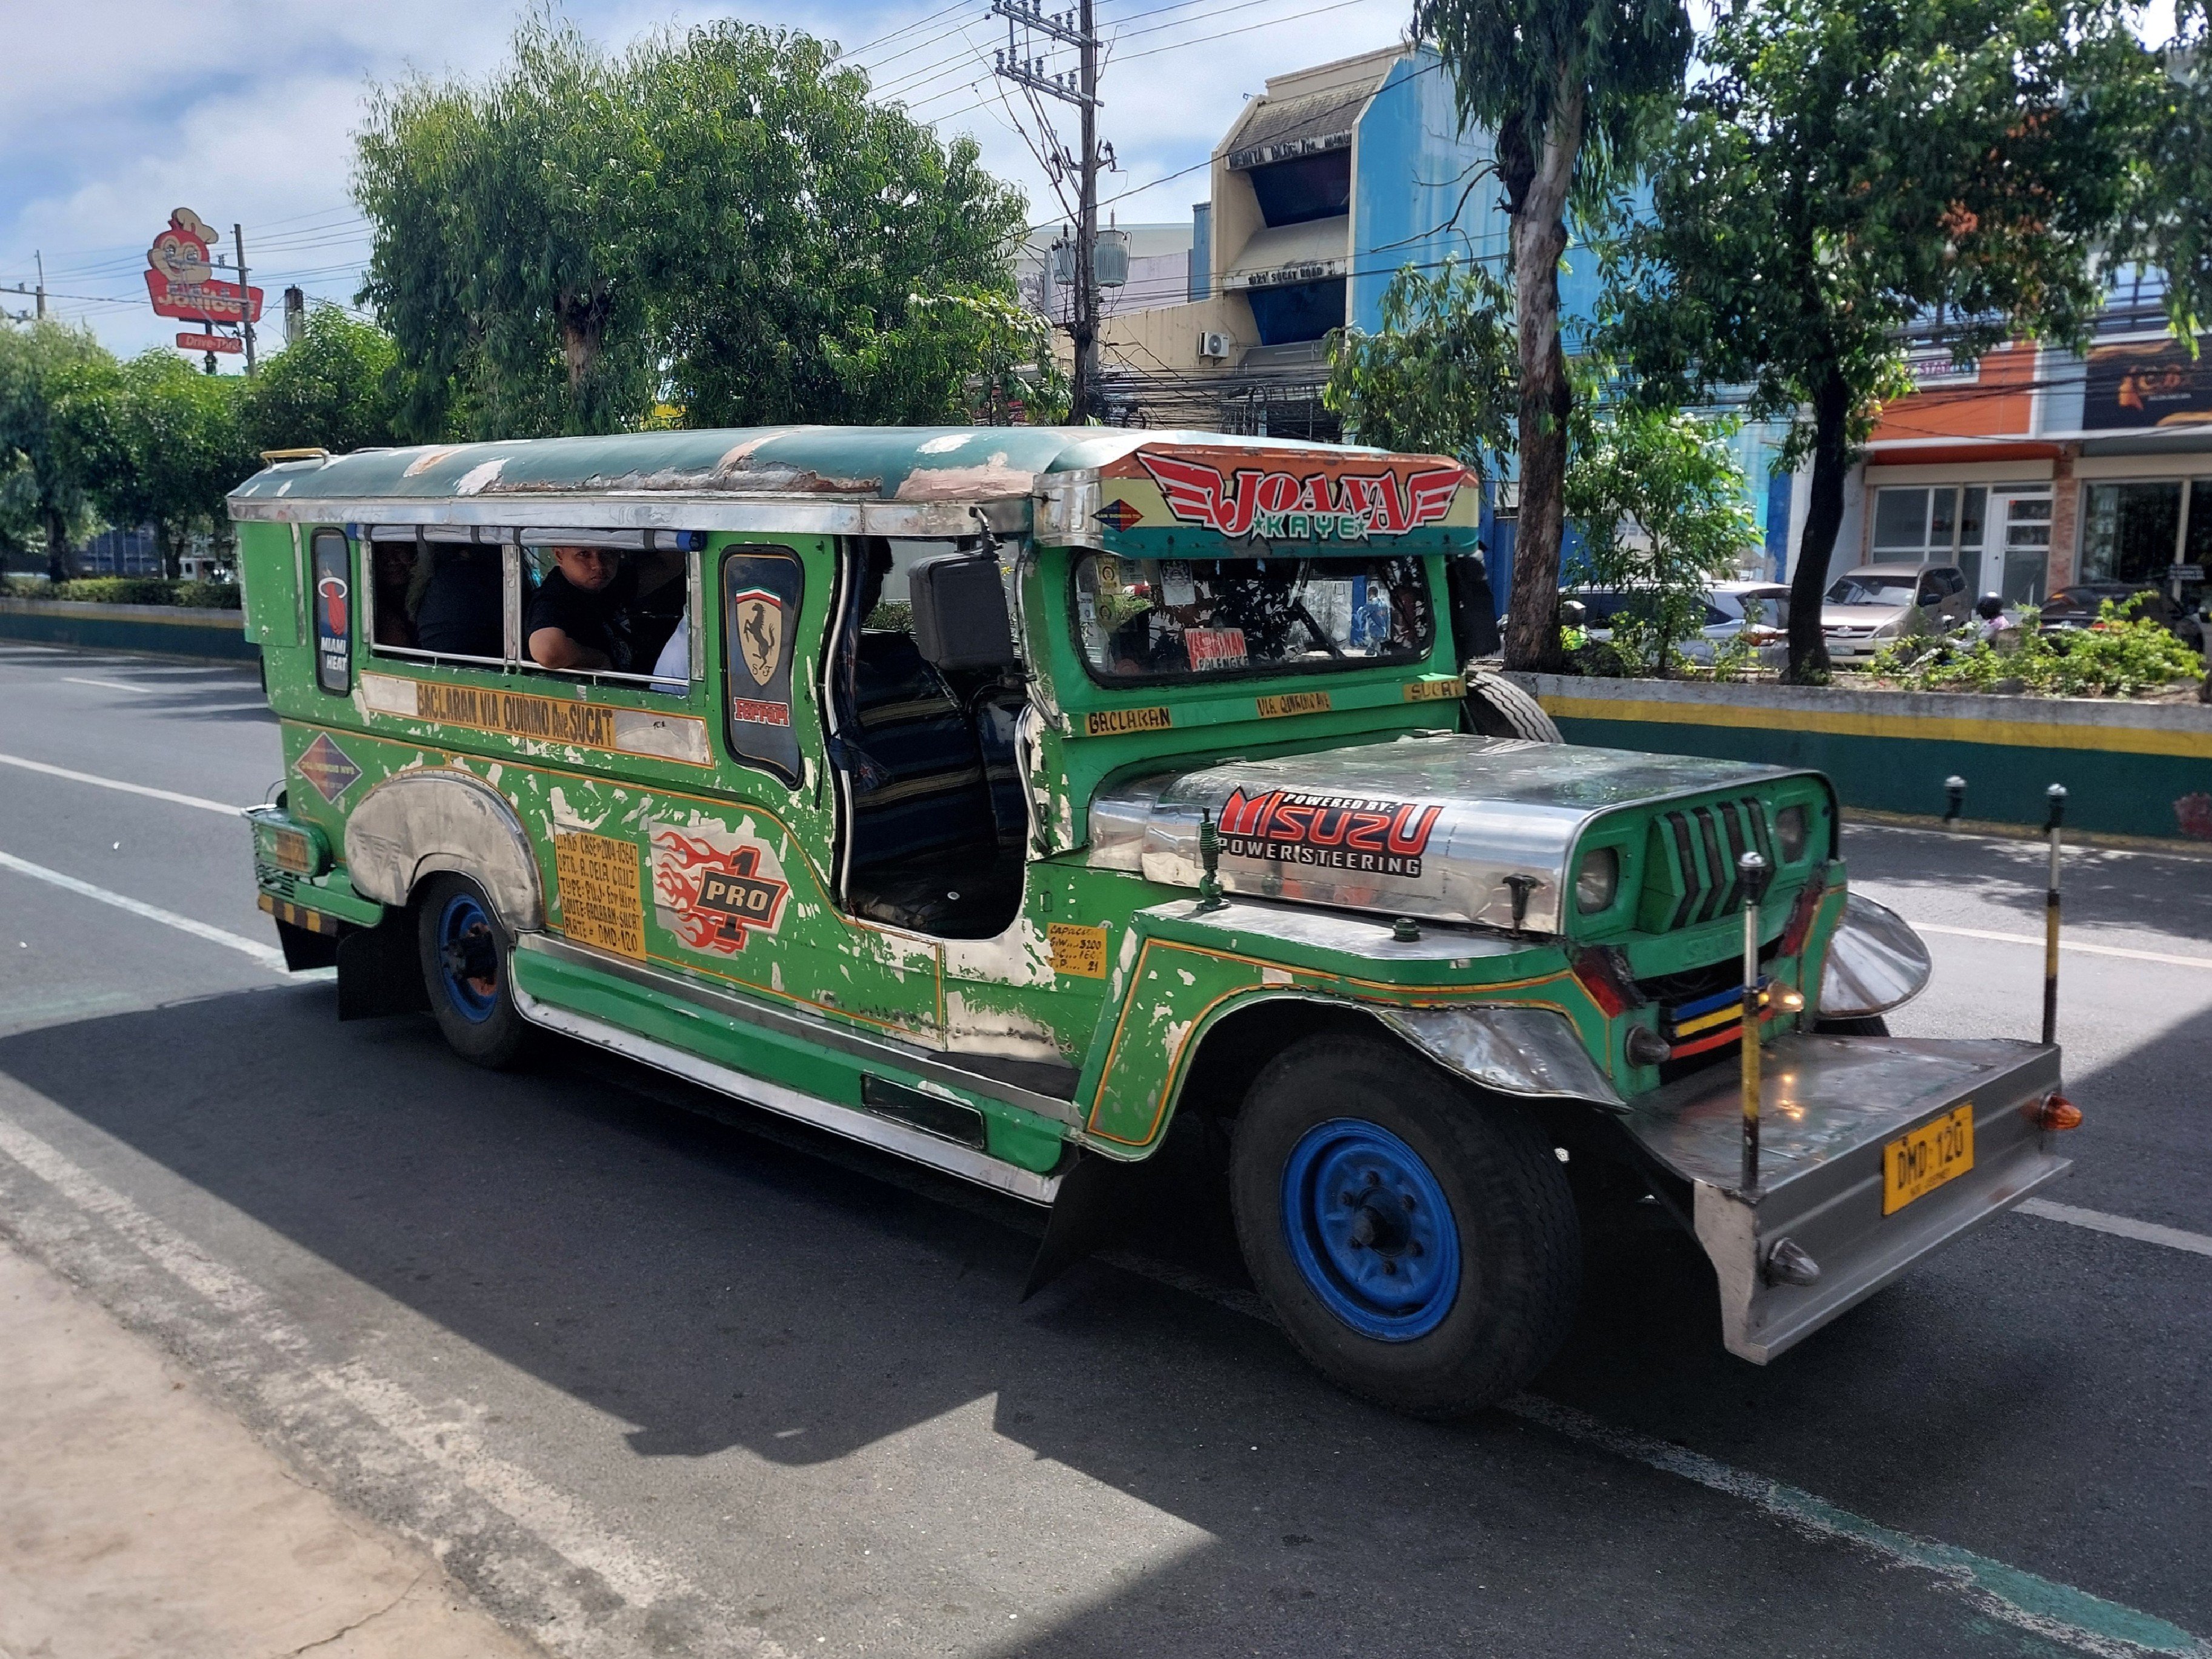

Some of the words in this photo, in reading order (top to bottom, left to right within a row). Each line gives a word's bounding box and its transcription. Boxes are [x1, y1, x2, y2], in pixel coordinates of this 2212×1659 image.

[1271, 271, 1296, 282] SUCAT
[1300, 267, 1322, 278] ROAD
[1266, 514, 1356, 537] KAYE
[321, 637, 347, 654] MIAMI
[326, 654, 348, 671] HEAT
[1411, 680, 1460, 700] SUCAT
[417, 684, 477, 724] BACLARAN
[480, 692, 499, 727] VIA
[503, 695, 549, 736] QUIRINO
[569, 703, 613, 746] SUCAT
[735, 698, 789, 726] Ferrari
[1089, 707, 1172, 734] BACLARAN
[1284, 793, 1365, 810] POWERED
[1365, 800, 1394, 814] BY:
[1218, 837, 1293, 860] POWER
[1302, 847, 1421, 875] STEERING
[612, 865, 635, 889] CRUZ
[706, 880, 769, 911] PRO
